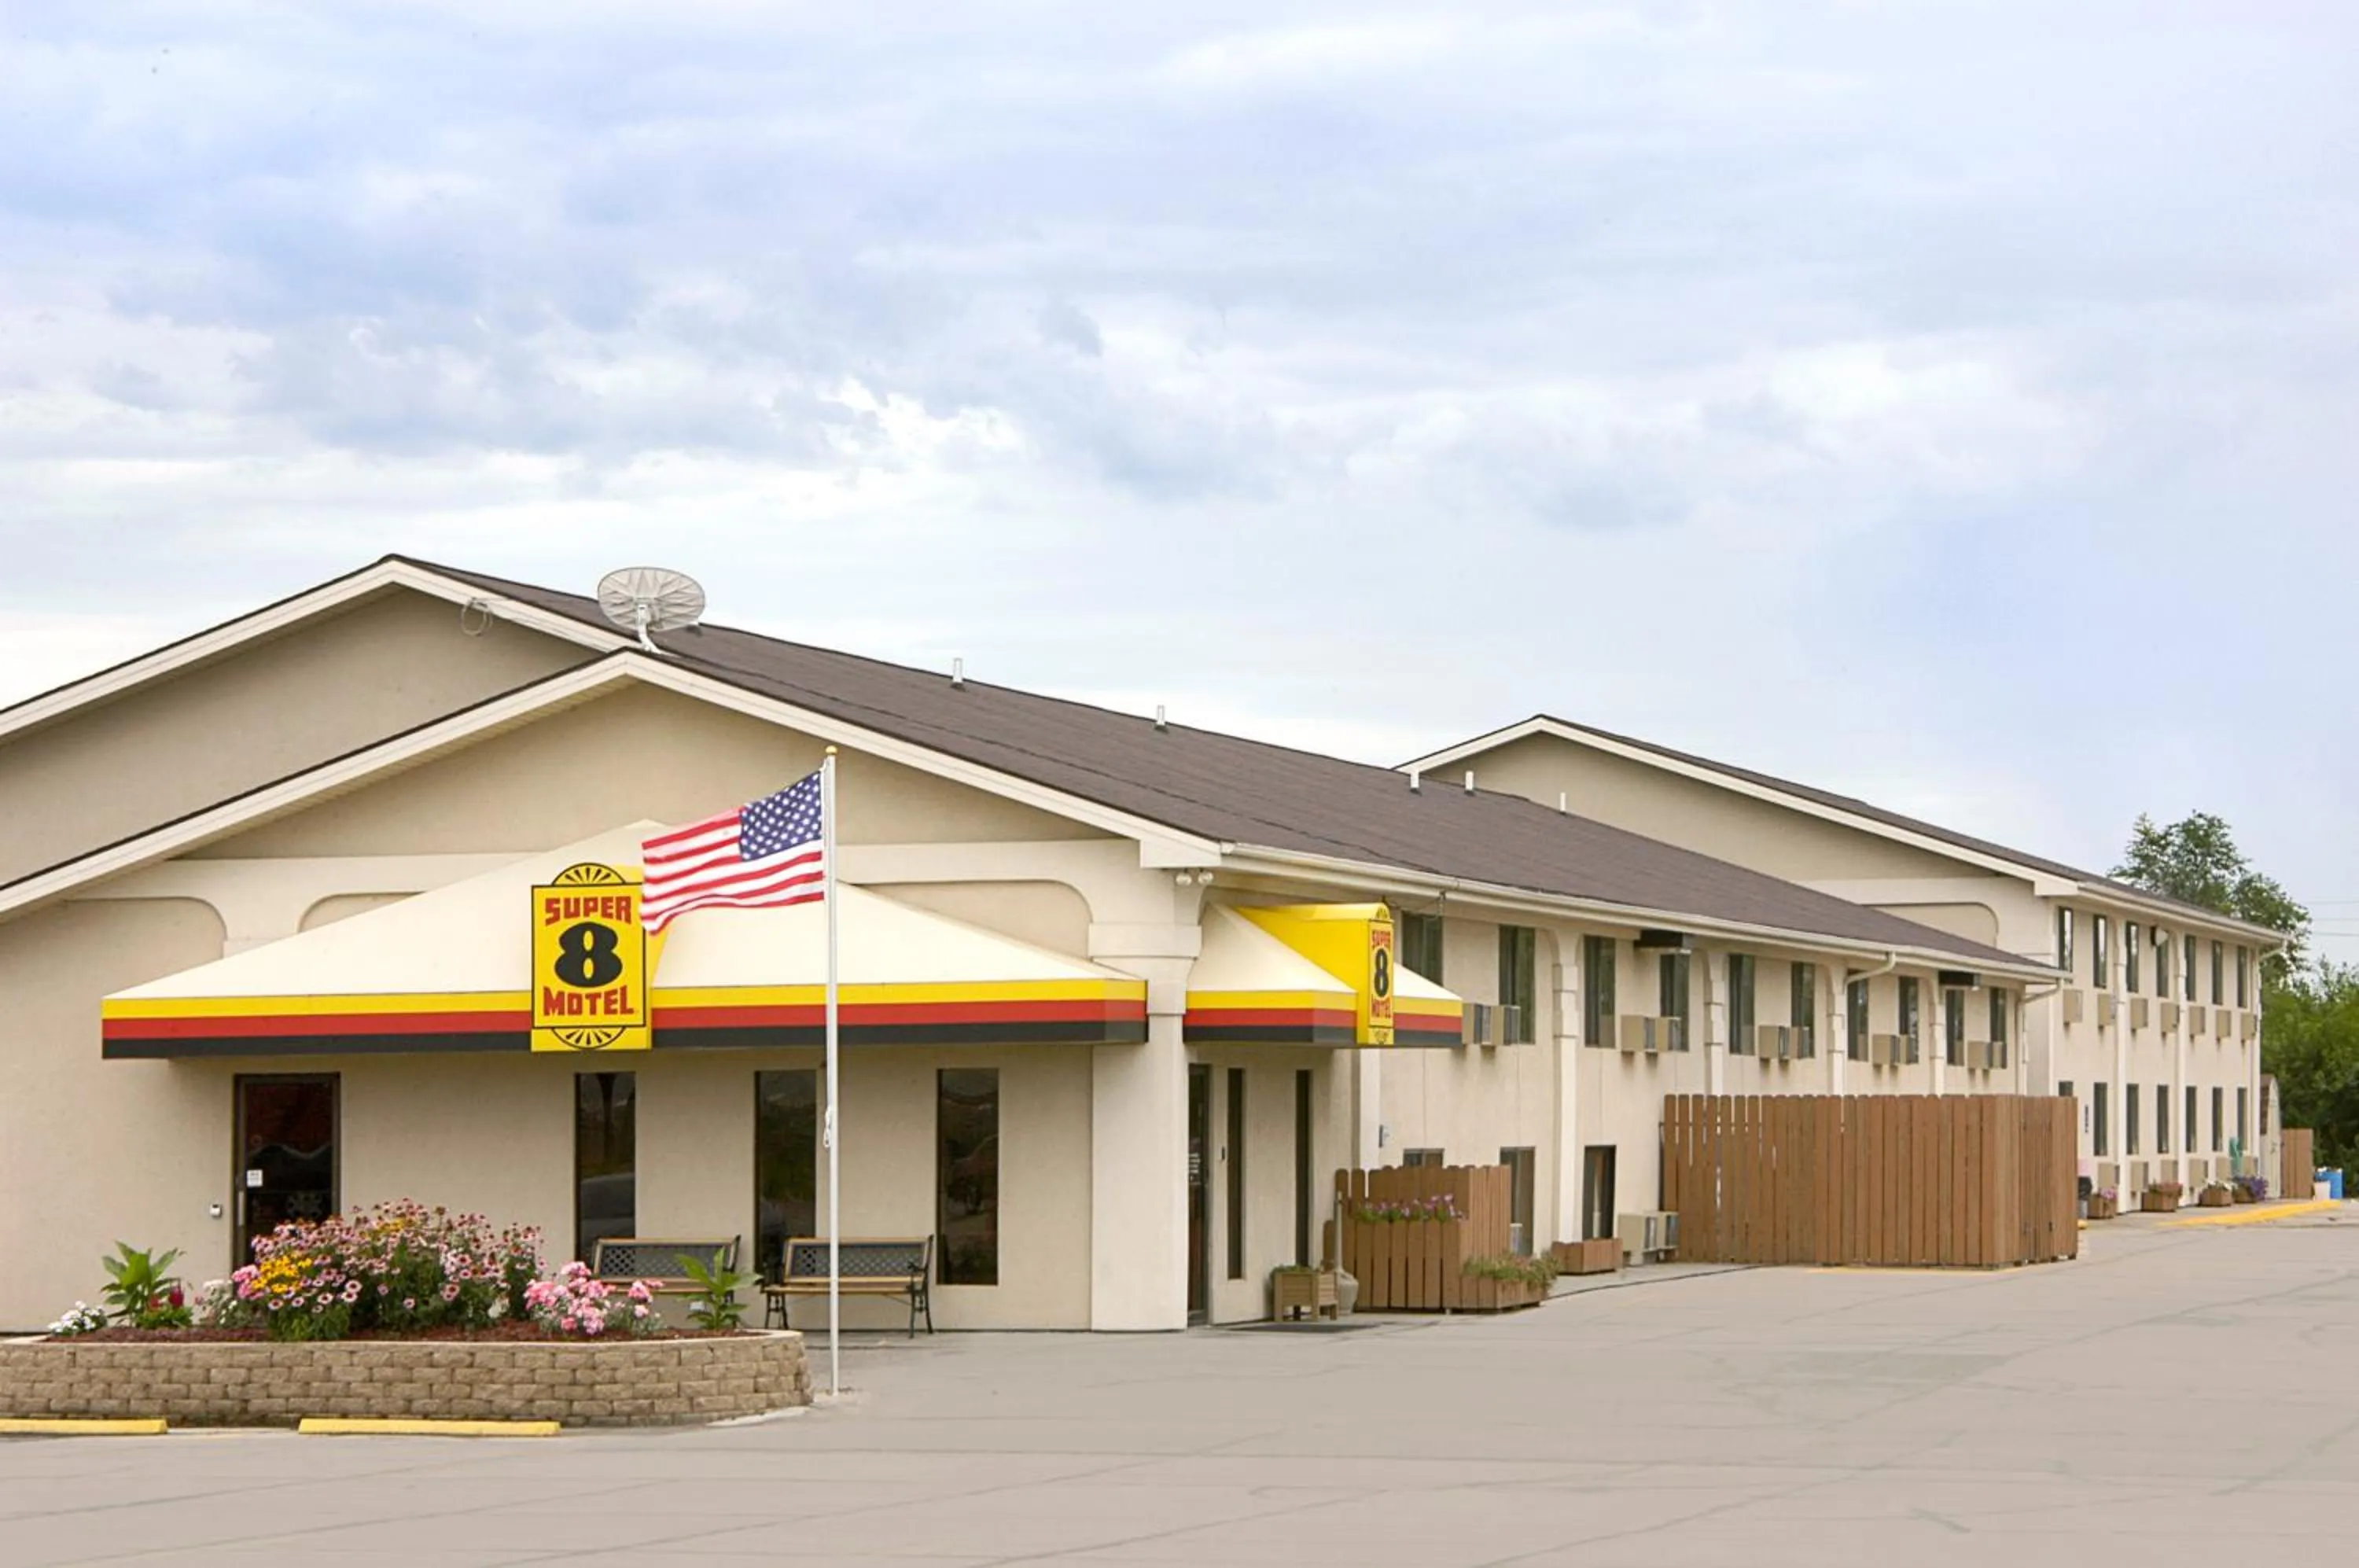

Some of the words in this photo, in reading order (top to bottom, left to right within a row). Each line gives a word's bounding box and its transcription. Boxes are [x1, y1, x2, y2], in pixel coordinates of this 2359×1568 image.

[545, 896, 631, 926] SUPER
[554, 922, 623, 988] 8
[1374, 948, 1389, 998] 8
[543, 985, 635, 1017] MOTEL
